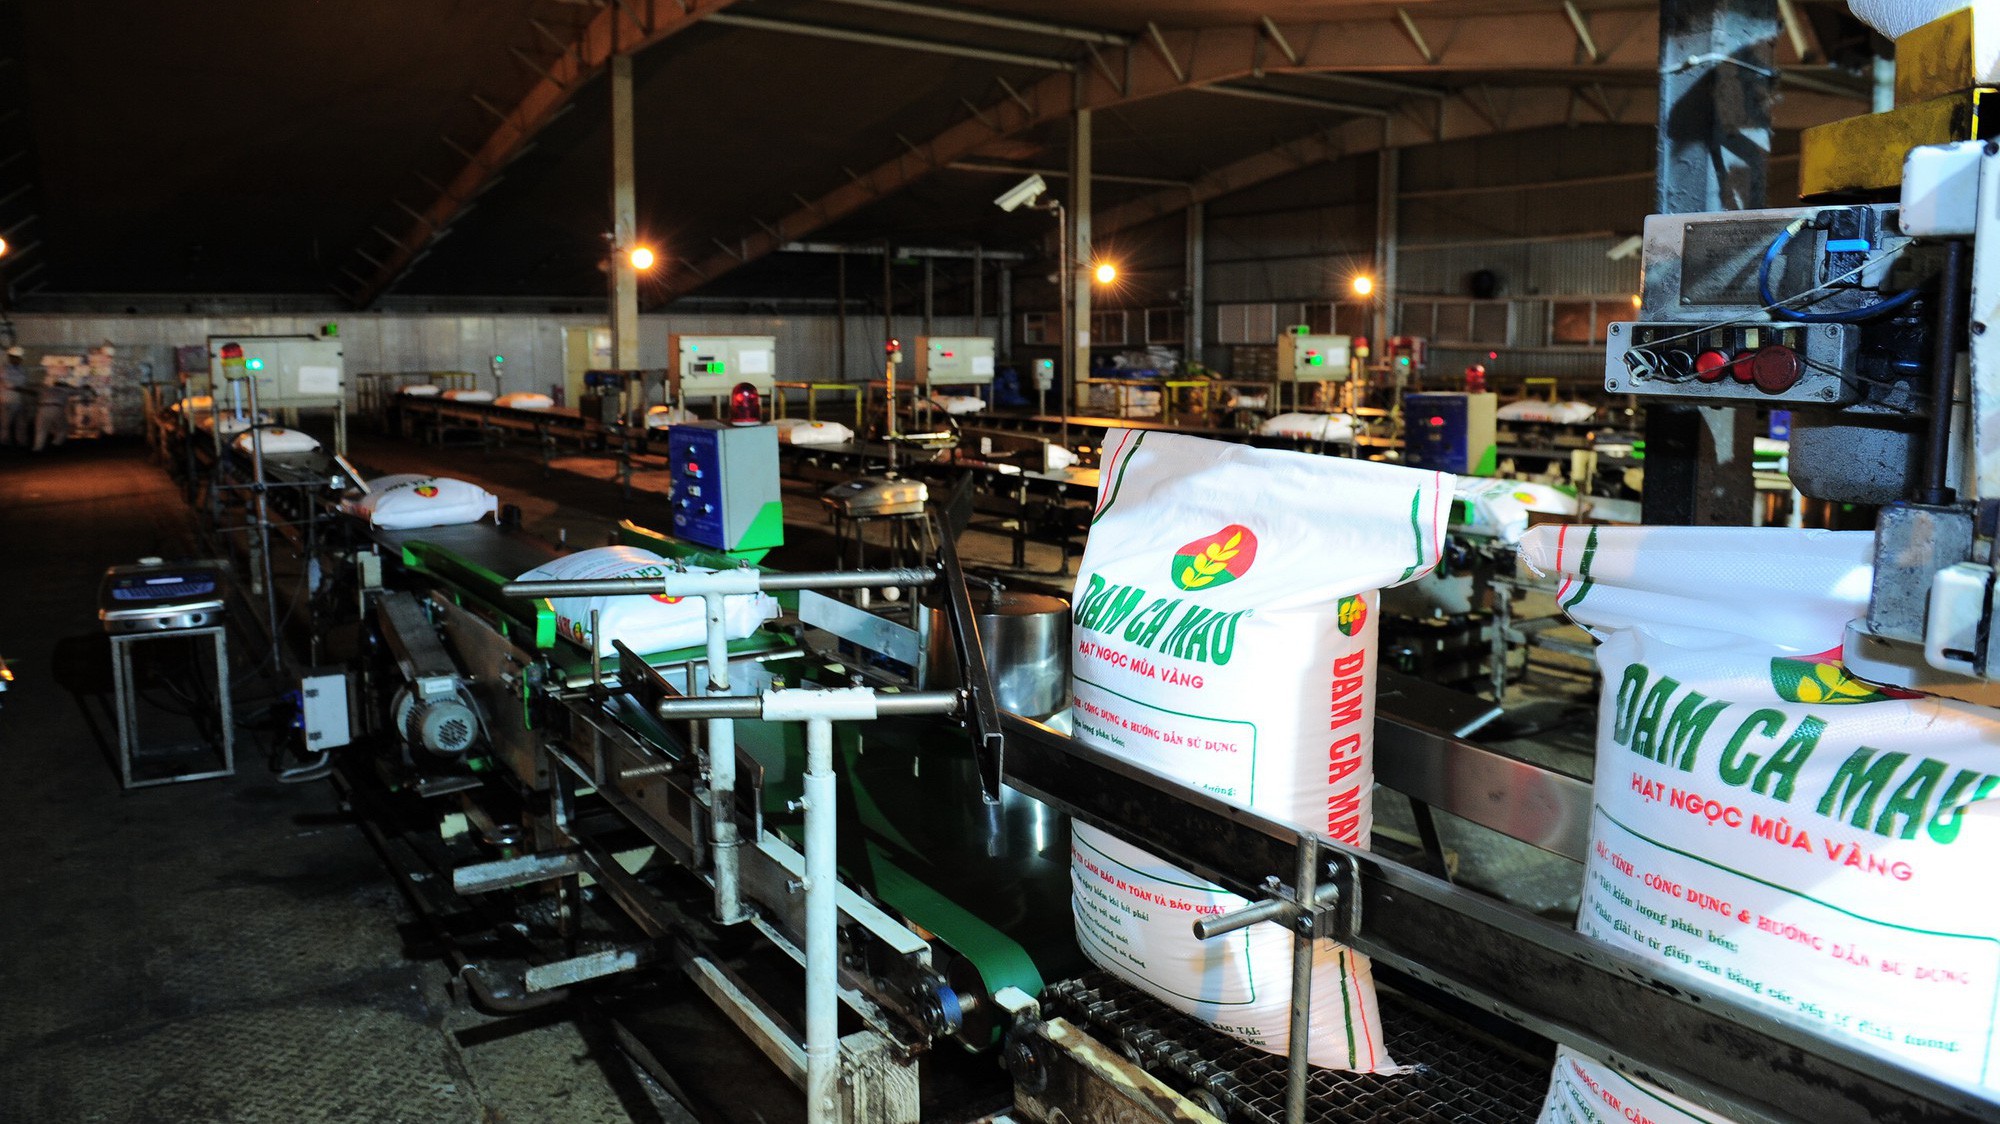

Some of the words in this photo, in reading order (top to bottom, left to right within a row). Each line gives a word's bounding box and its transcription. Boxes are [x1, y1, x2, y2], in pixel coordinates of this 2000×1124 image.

[1123, 598, 1183, 649] CA
[1159, 604, 1247, 666] MAU
[1079, 640, 1096, 659] HẠT
[1096, 646, 1128, 668] NGỌC
[1161, 667, 1204, 689] VÀNG
[1331, 648, 1365, 730] DAM
[1121, 719, 1129, 729] &
[1328, 733, 1362, 785] CA
[1613, 662, 1732, 773] DAM
[1719, 708, 1829, 803] CA
[1816, 745, 2000, 844] MAU
[1631, 771, 1667, 806] HẠT
[1669, 787, 1744, 827] NGỌC
[1750, 815, 1814, 854] MÙA
[1824, 837, 1914, 882] VÀNG
[1116, 880, 1127, 892] AN
[1129, 885, 1152, 901] TOÀN
[1154, 893, 1167, 907] VÀ
[1611, 853, 1635, 878] TÍNH
[1644, 872, 1682, 899] CÔNG
[1687, 888, 1731, 918] DỤNG
[1737, 909, 1752, 925] &
[1612, 882, 1633, 908] kiệm
[1671, 917, 1703, 939] phân
[1613, 918, 1631, 936] giải
[1601, 1089, 1622, 1113] TIN
